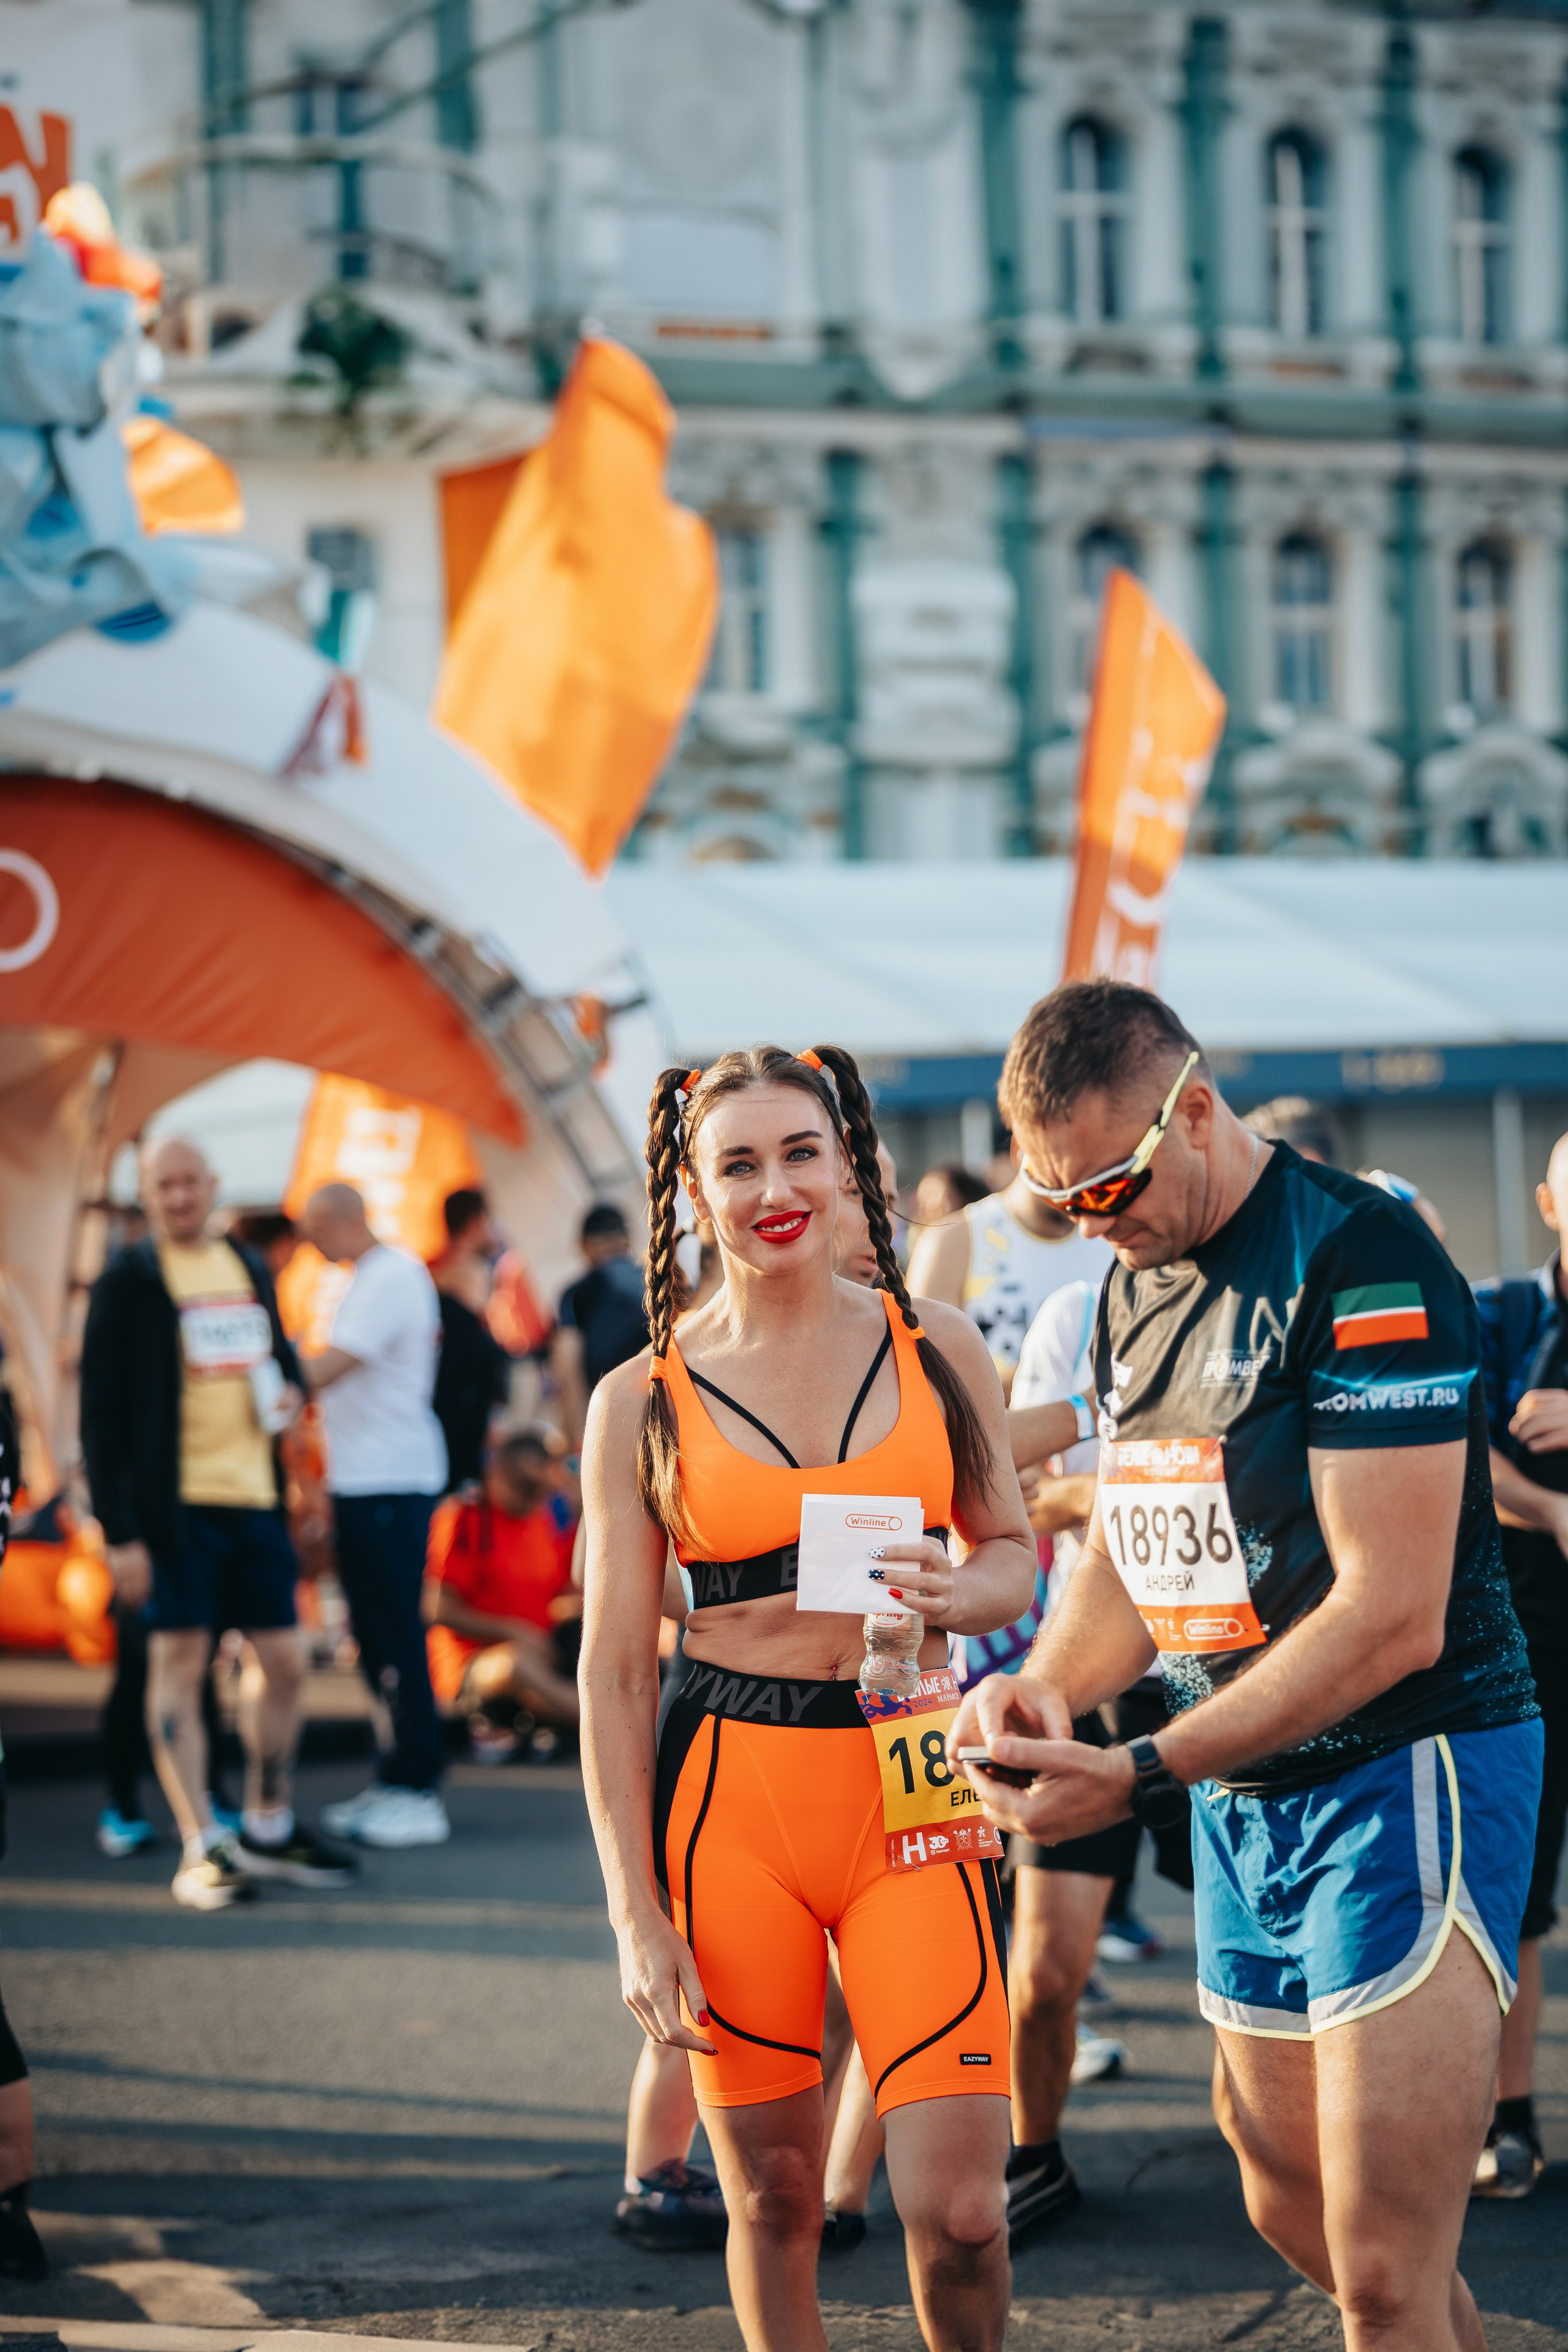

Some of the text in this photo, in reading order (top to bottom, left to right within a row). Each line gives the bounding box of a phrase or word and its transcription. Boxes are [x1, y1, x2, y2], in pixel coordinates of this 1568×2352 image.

[851, 1517, 886, 1526] Winline
[1110, 1502, 1232, 1566] 18936
[1146, 1570, 1194, 1593] АНДРЕЙ
[1188, 1623, 1224, 1635] Winline
[685, 1666, 823, 1721] YWAY
[913, 1698, 933, 1708] 2024
